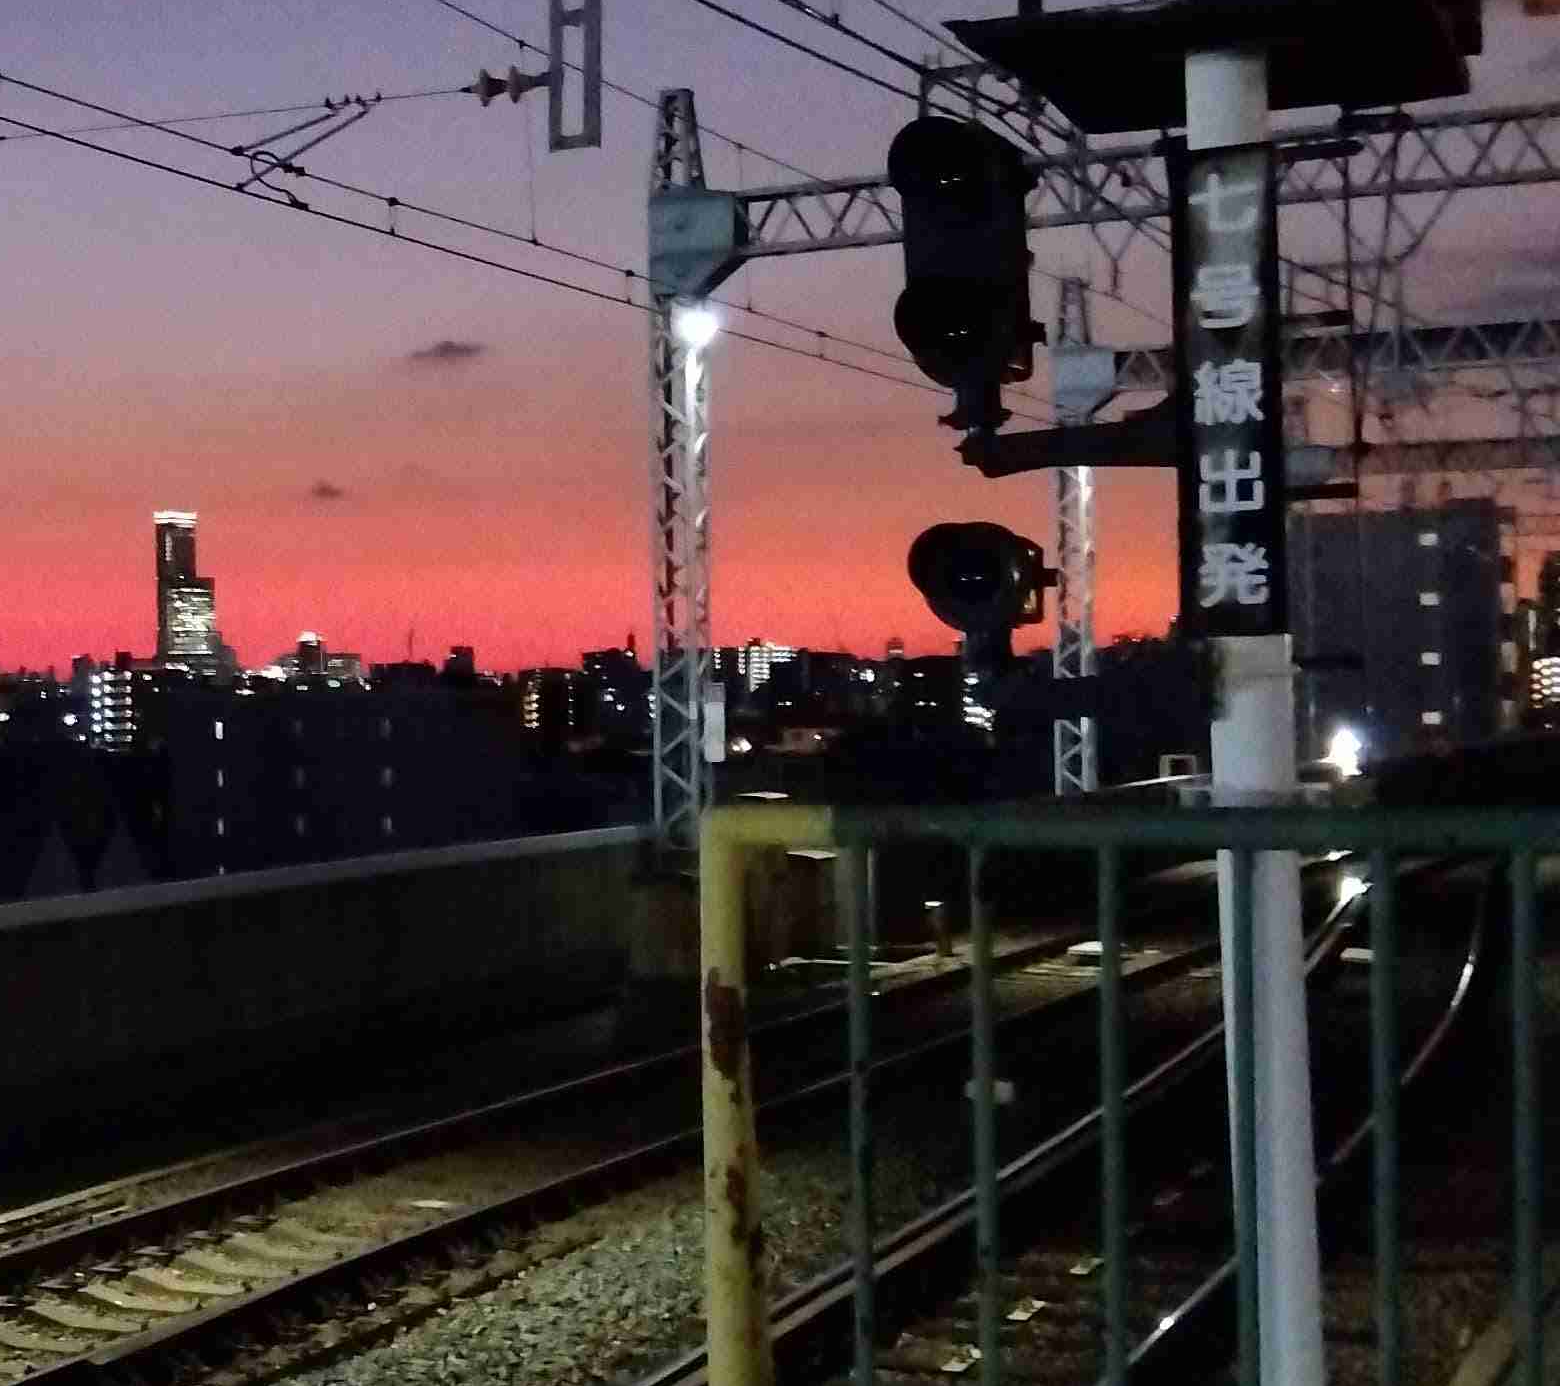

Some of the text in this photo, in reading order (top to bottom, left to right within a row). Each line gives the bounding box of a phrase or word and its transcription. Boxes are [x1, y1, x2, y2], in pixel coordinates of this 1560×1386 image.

[1188, 172, 1270, 608] 七号線出発
